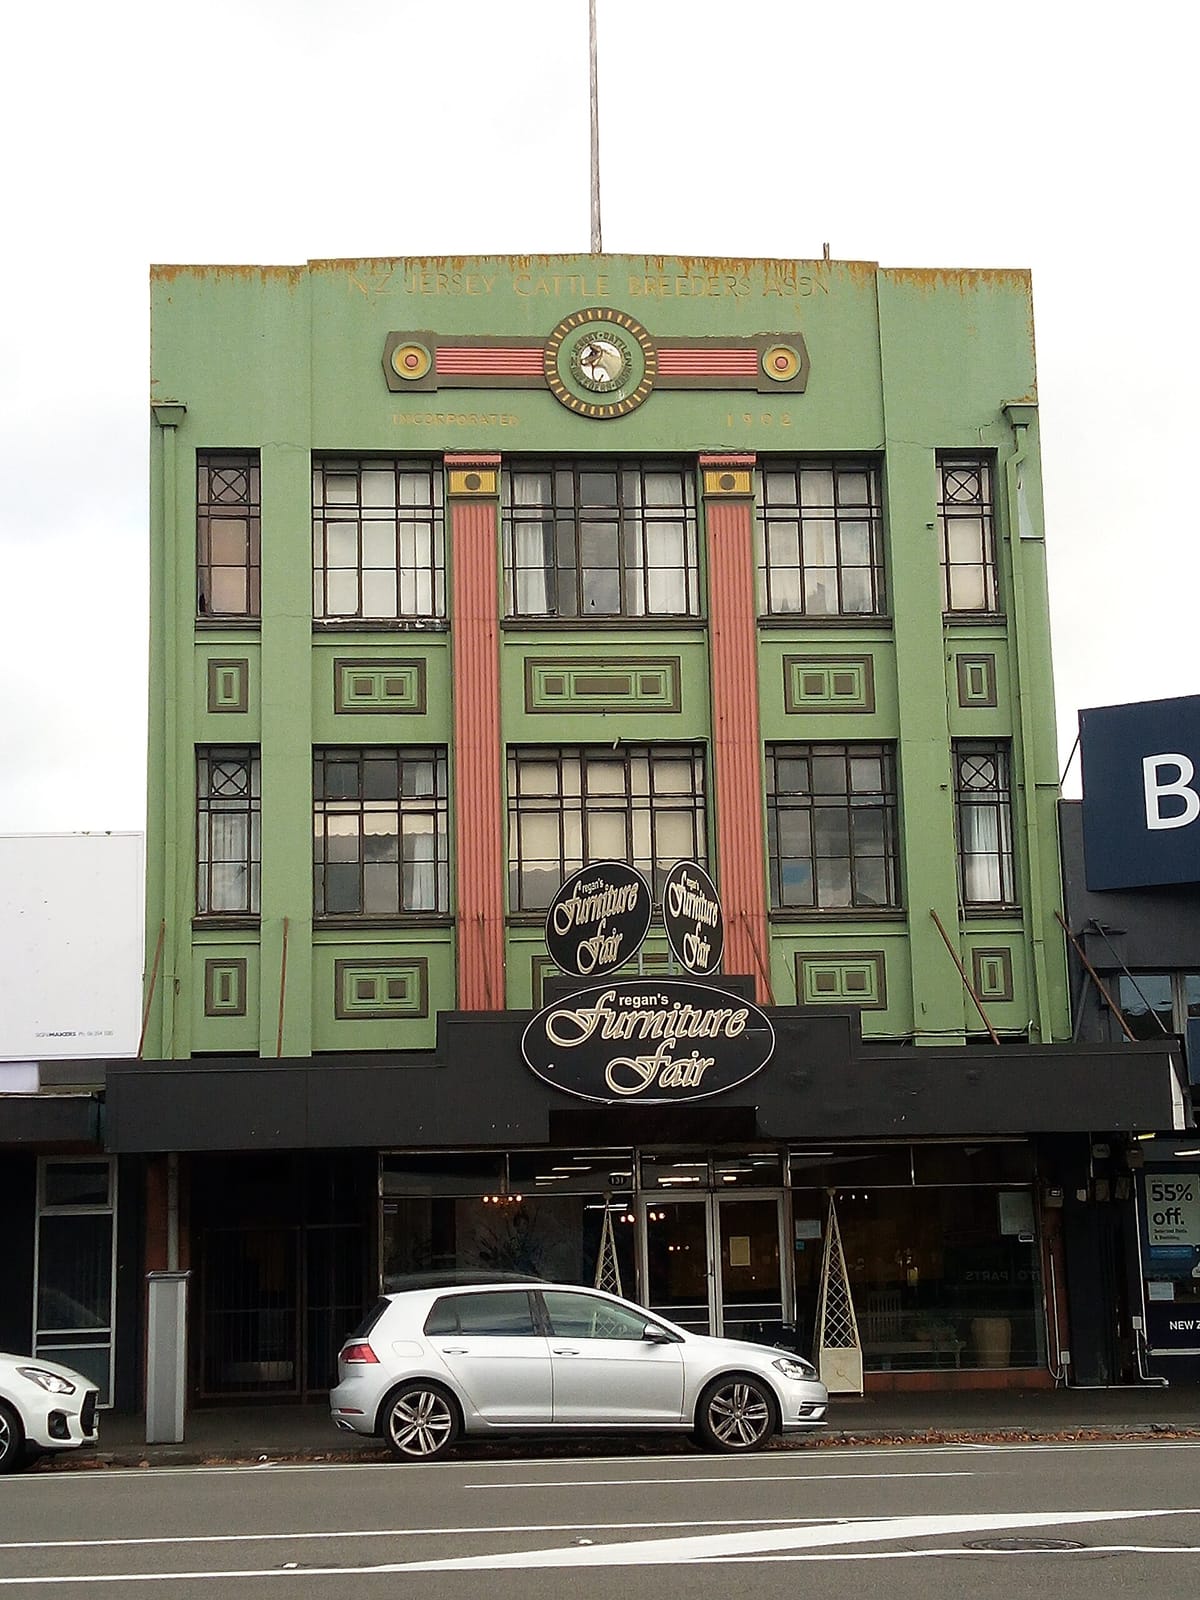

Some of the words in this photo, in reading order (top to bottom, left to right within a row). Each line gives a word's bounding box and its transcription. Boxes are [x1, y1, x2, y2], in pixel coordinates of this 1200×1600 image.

[405, 273, 497, 295] JERSEY
[512, 274, 610, 297] CATTLE
[628, 275, 751, 297] BREEDERS
[762, 275, 830, 297] ASSN
[392, 413, 520, 426] INCORPORATED
[582, 878, 604, 894] regan's
[553, 880, 639, 936] Furniture
[668, 870, 719, 928] Furniture
[576, 918, 623, 974] Fair
[683, 921, 711, 969] Fair
[619, 993, 669, 1009] regan's
[545, 990, 749, 1048] Furniture
[605, 1038, 714, 1095] Fair
[1151, 1183, 1193, 1201] 55%
[1152, 1207, 1185, 1226] off.
[1169, 1320, 1194, 1331] NEW
